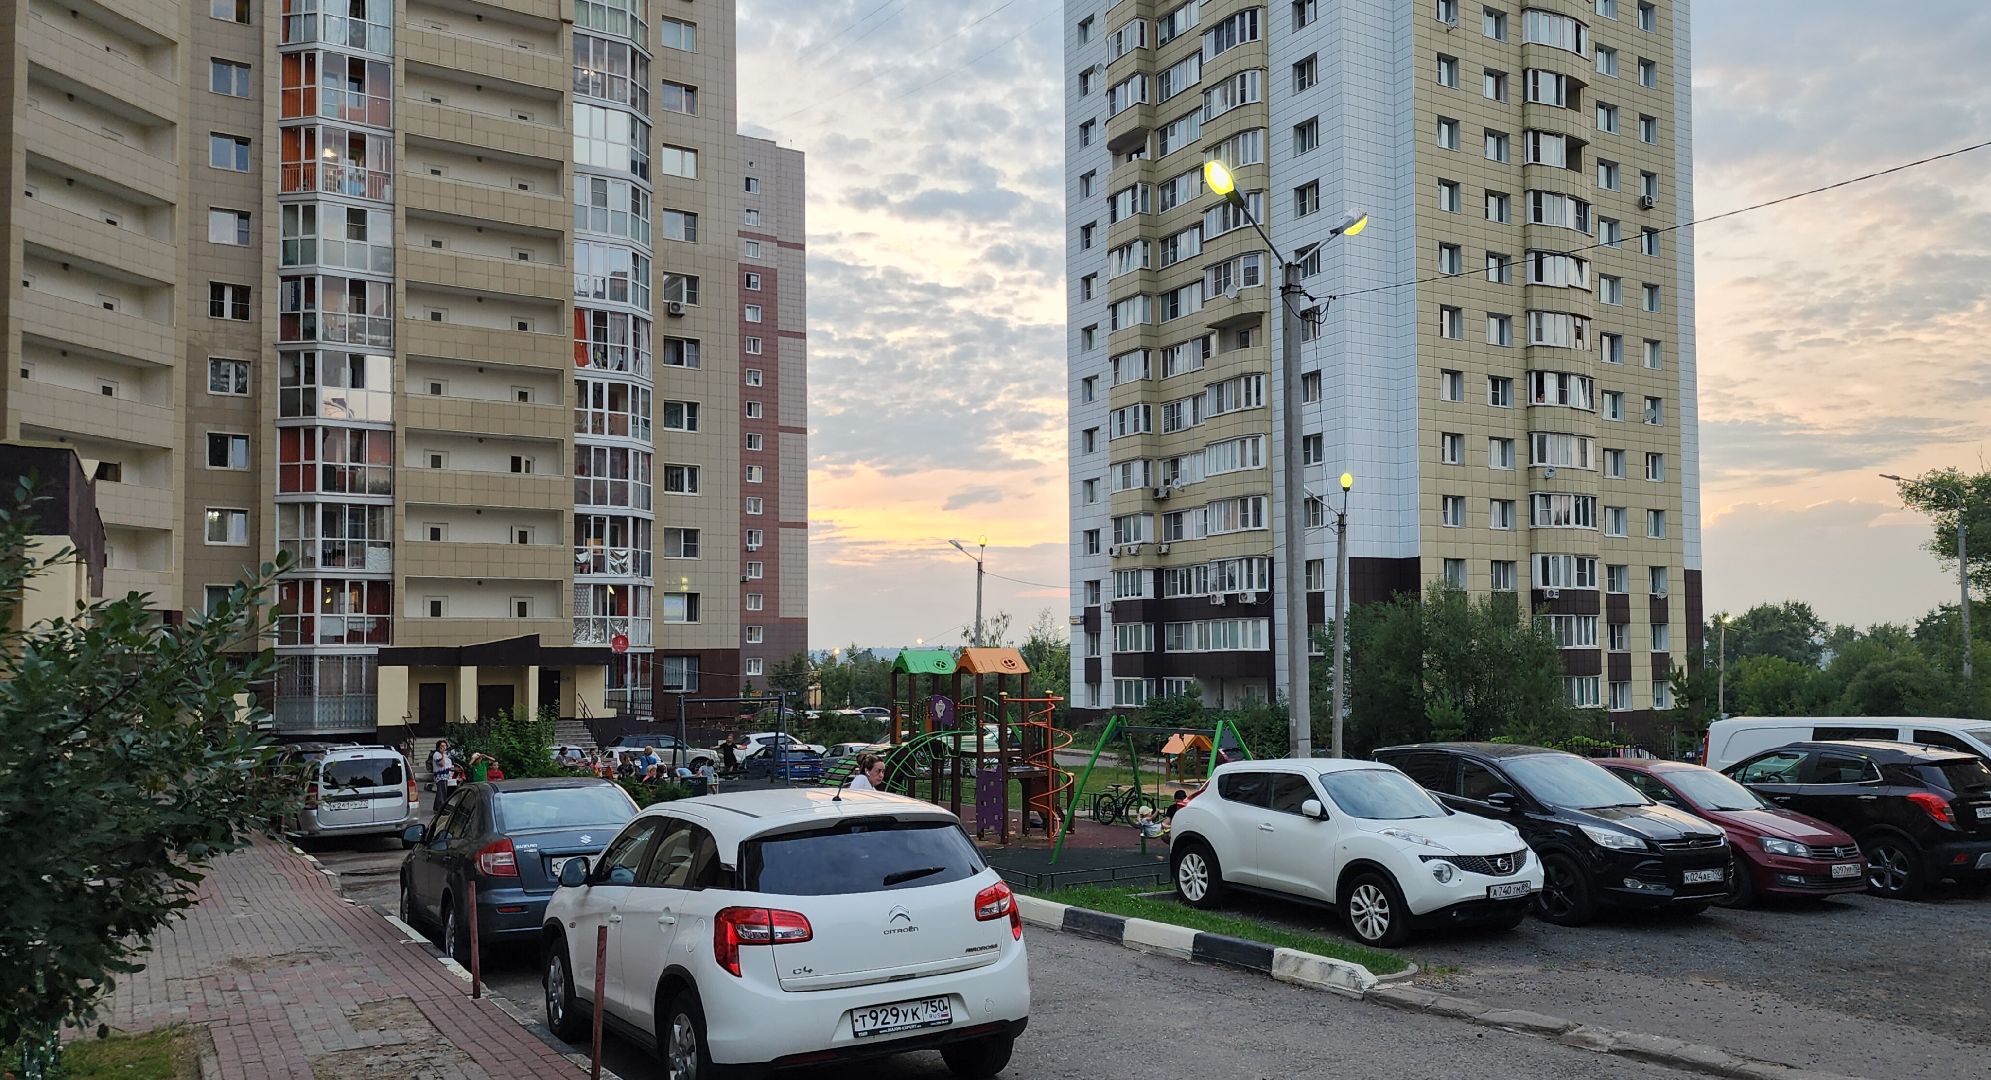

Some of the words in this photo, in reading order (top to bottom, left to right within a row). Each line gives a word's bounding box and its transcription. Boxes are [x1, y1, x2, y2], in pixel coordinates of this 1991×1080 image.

[792, 965, 813, 975] C4
[859, 1006, 921, 1028] Т929УК
[922, 999, 945, 1015] 750
